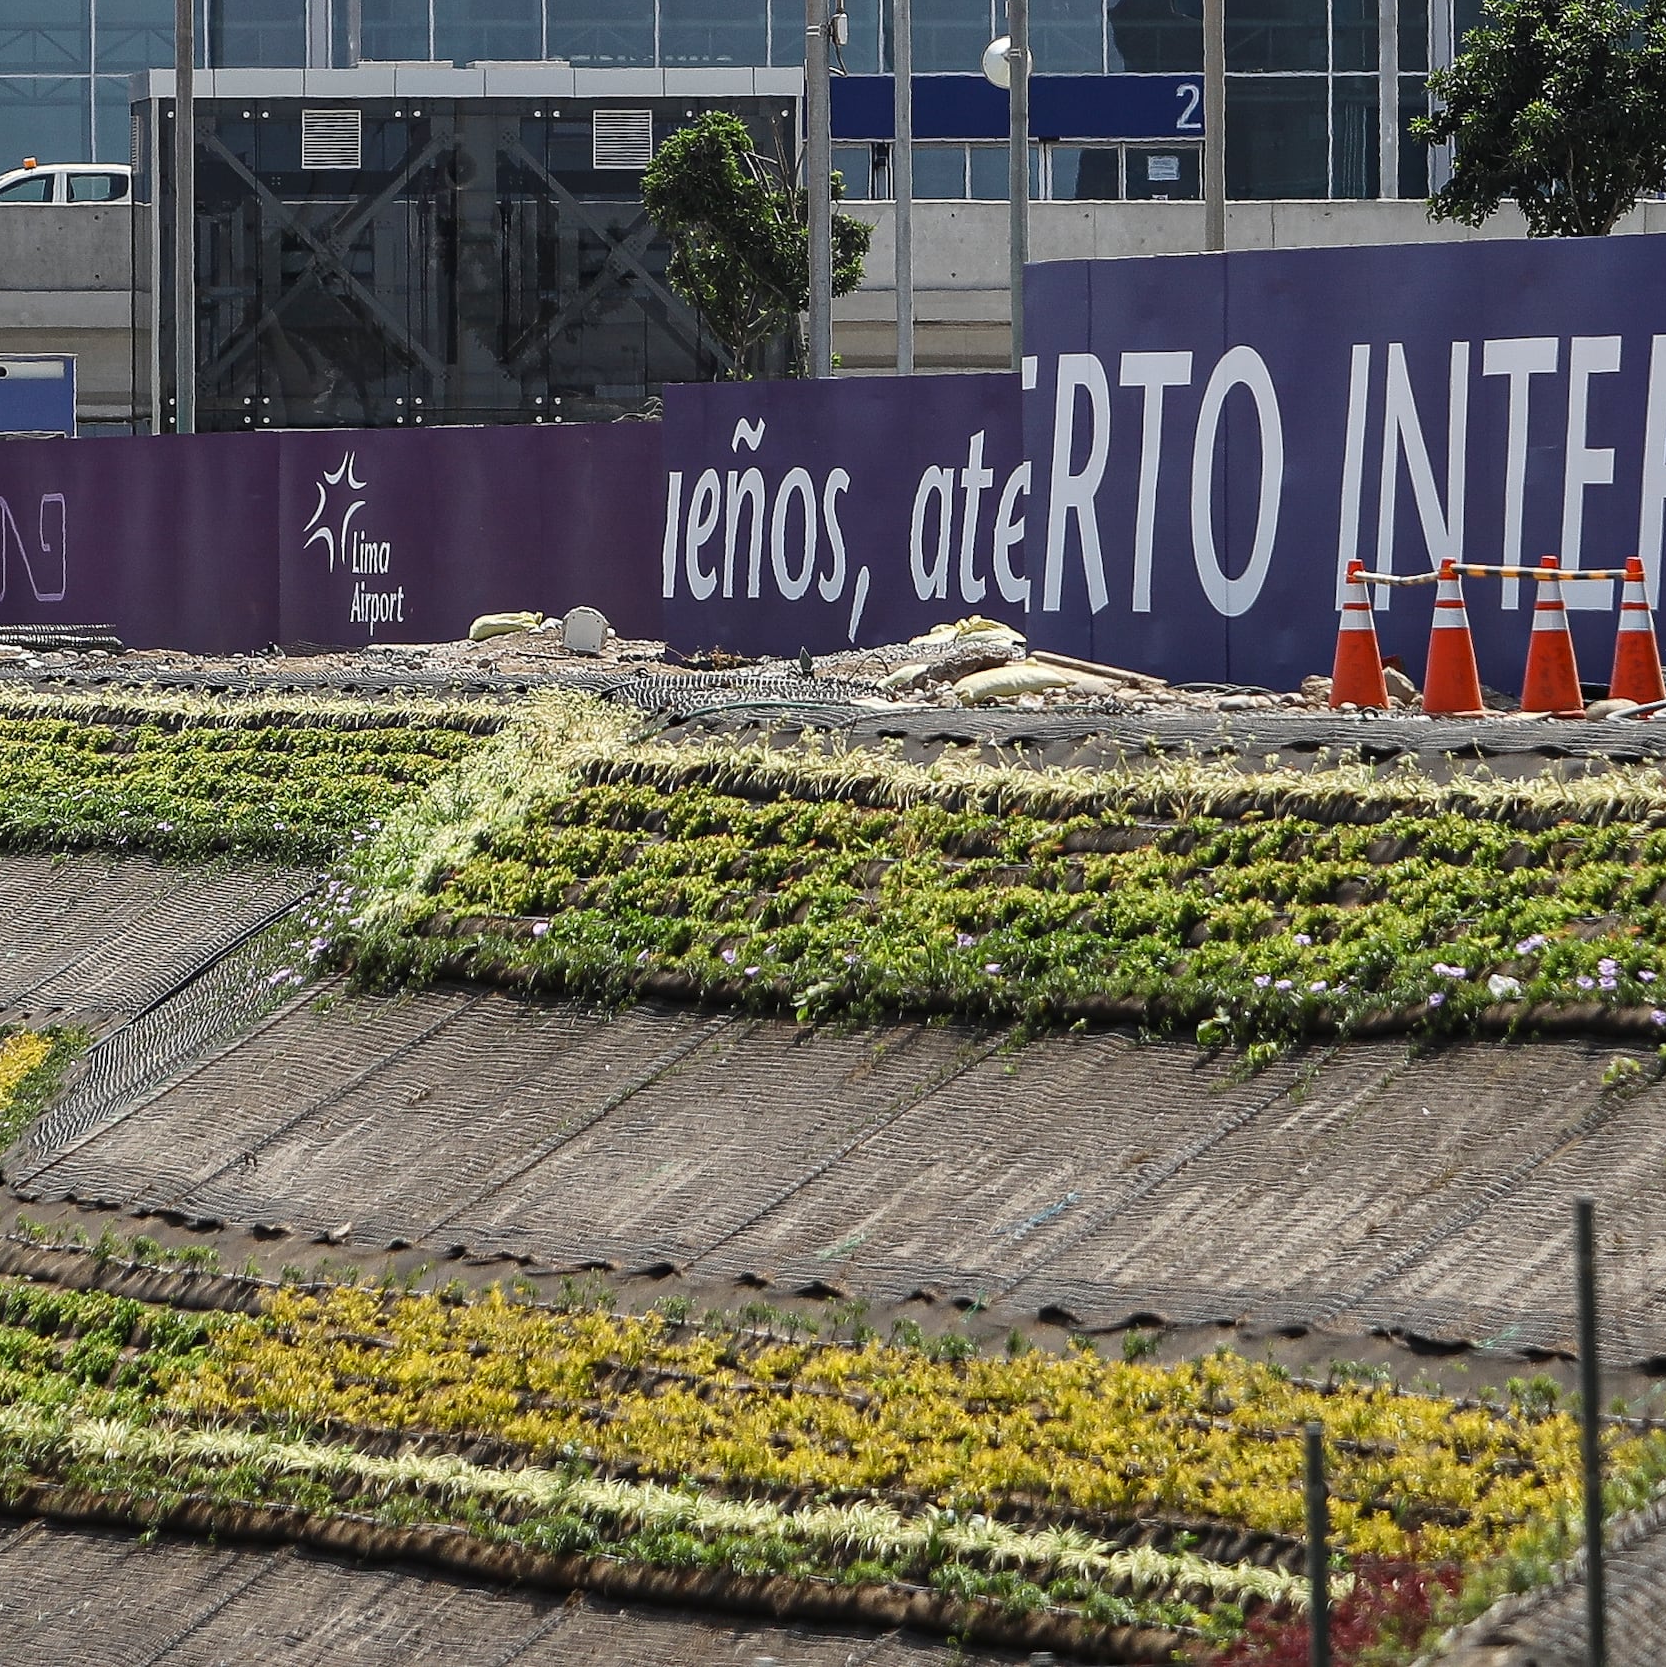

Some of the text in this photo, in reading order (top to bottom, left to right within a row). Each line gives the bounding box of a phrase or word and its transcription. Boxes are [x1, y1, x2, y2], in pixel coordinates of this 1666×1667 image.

[1176, 83, 1202, 129] 2
[1022, 344, 1284, 618] RTO
[352, 530, 391, 574] Lima
[350, 581, 405, 637] Airport
